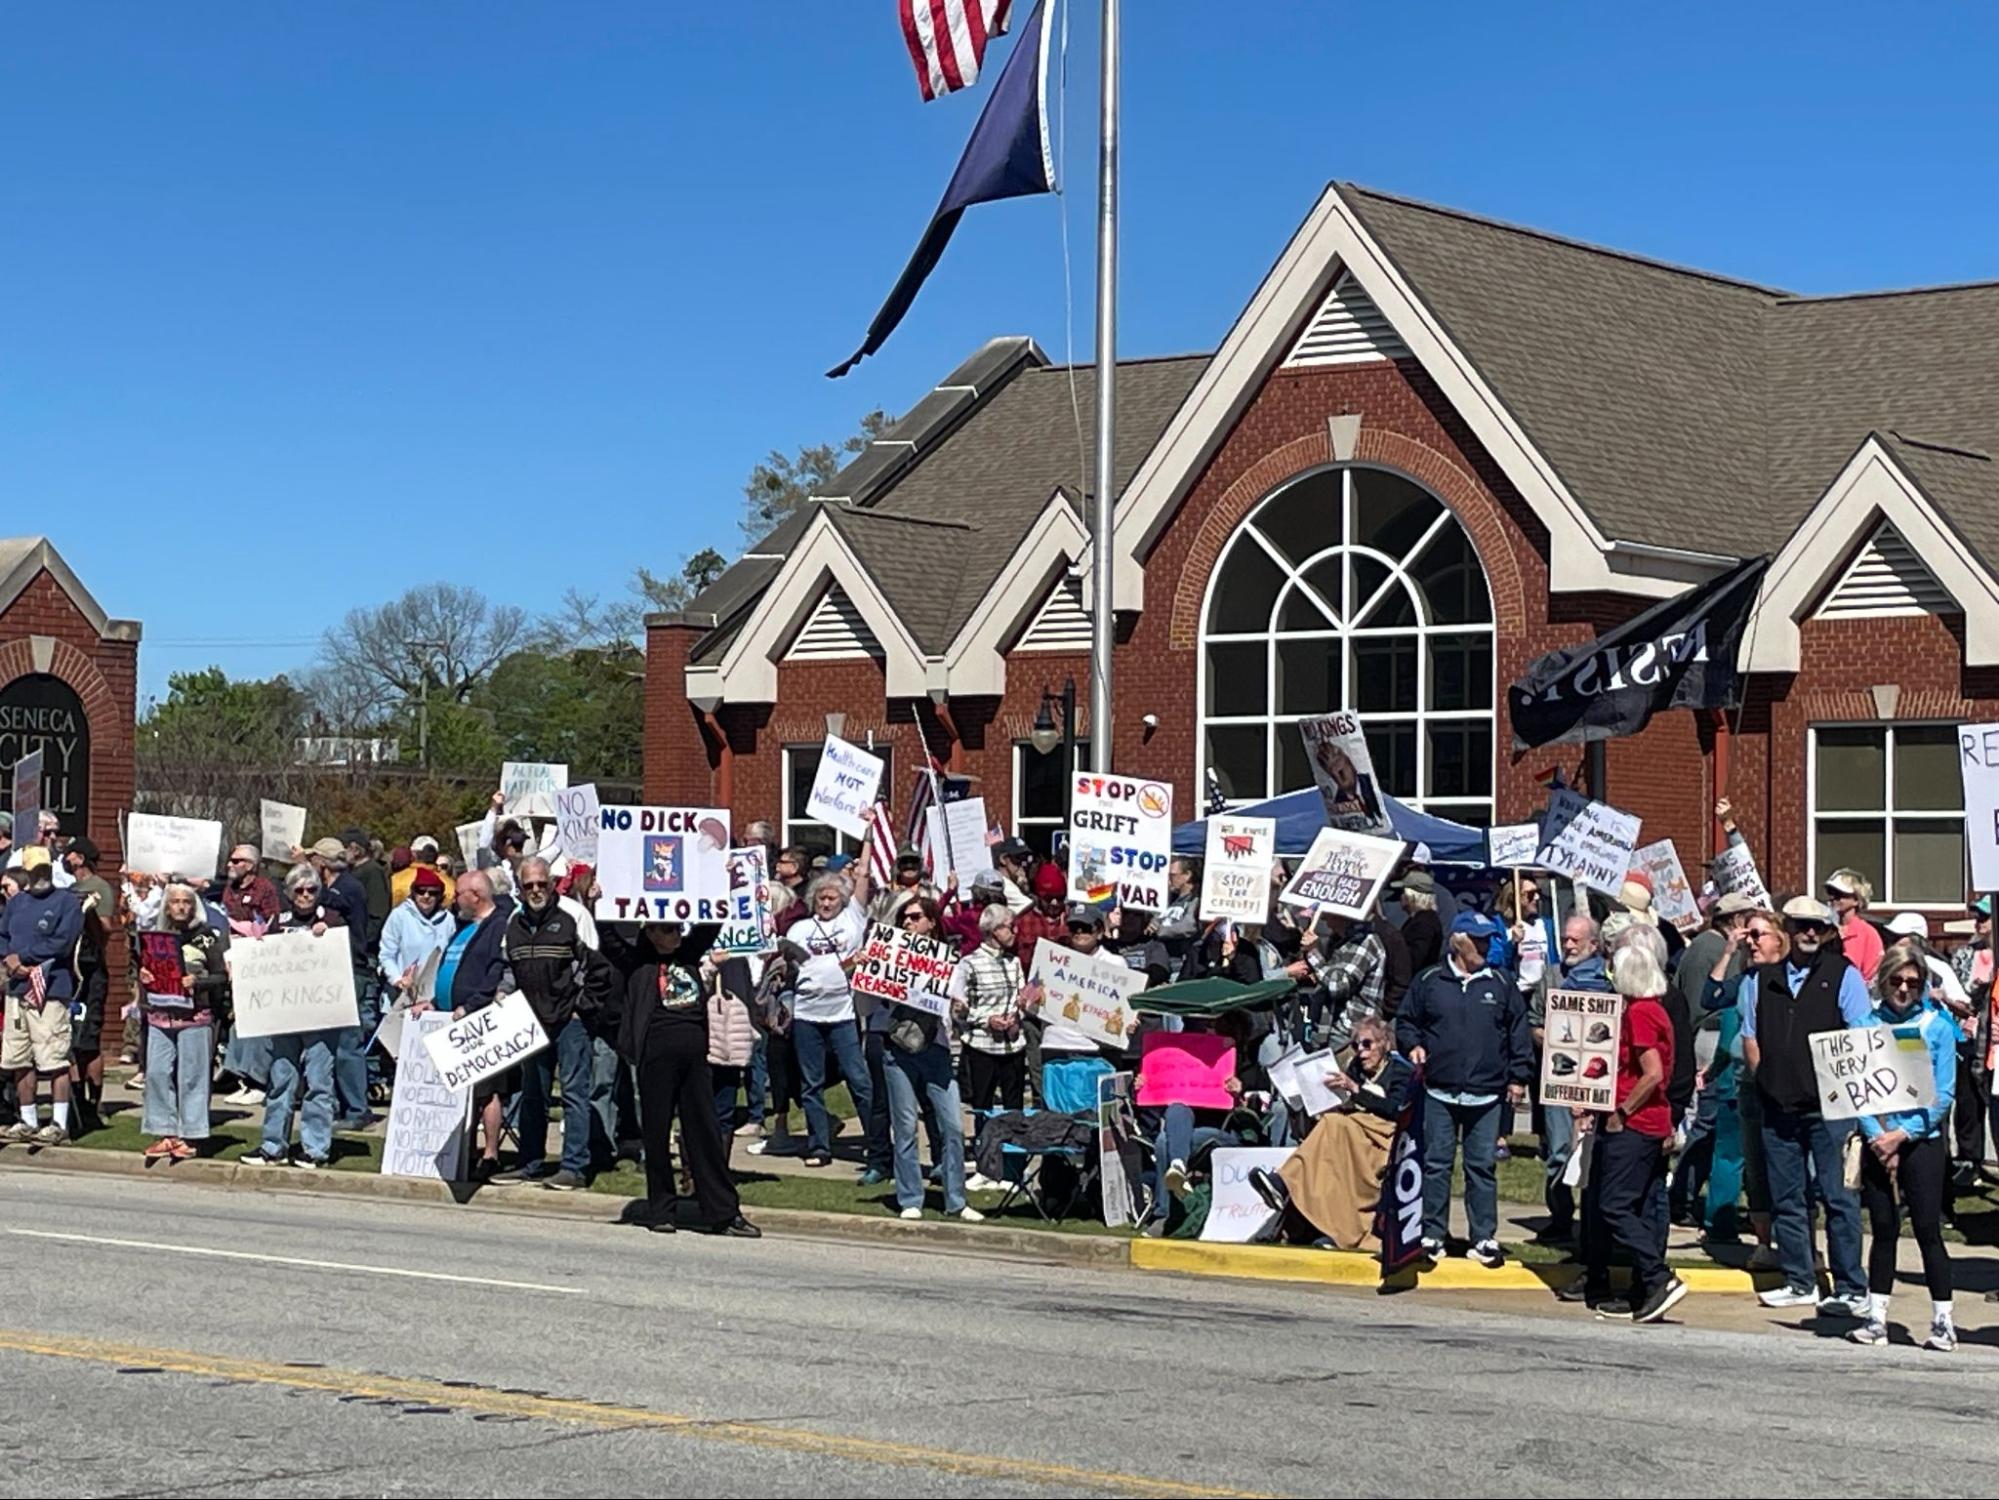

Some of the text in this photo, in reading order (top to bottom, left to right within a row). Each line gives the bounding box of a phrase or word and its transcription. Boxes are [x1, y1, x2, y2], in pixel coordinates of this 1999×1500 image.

[0, 706, 76, 734] SENECA
[0, 732, 78, 773] CITY
[1077, 777, 1137, 802] STOP
[557, 791, 586, 817] NO
[602, 808, 699, 833] NO DICK
[1073, 810, 1140, 836] GRIFT
[1110, 845, 1168, 874] STOP
[1545, 842, 1618, 887] TYRANNY
[1222, 873, 1255, 889] STOP
[1299, 879, 1361, 906] ENOUGH
[615, 897, 729, 920] TATORS
[250, 944, 281, 960] SAVE
[872, 923, 962, 965] NO SIGN IS
[867, 941, 893, 962] BIG
[894, 949, 955, 980] ENOUGH
[1049, 948, 1129, 988] WE LOVE
[852, 971, 909, 1001] REASONS
[884, 963, 921, 989] LIST
[921, 977, 952, 1000] ALL
[1053, 967, 1121, 1002] AMERICA
[249, 988, 274, 1010] NO
[1551, 994, 1618, 1016] SAME SHIT
[448, 1010, 498, 1049] SAVE
[461, 1038, 486, 1055] OUR
[1815, 1029, 1886, 1059] THIS IS
[1829, 1053, 1868, 1080] VERY
[1845, 1066, 1898, 1111] BAD
